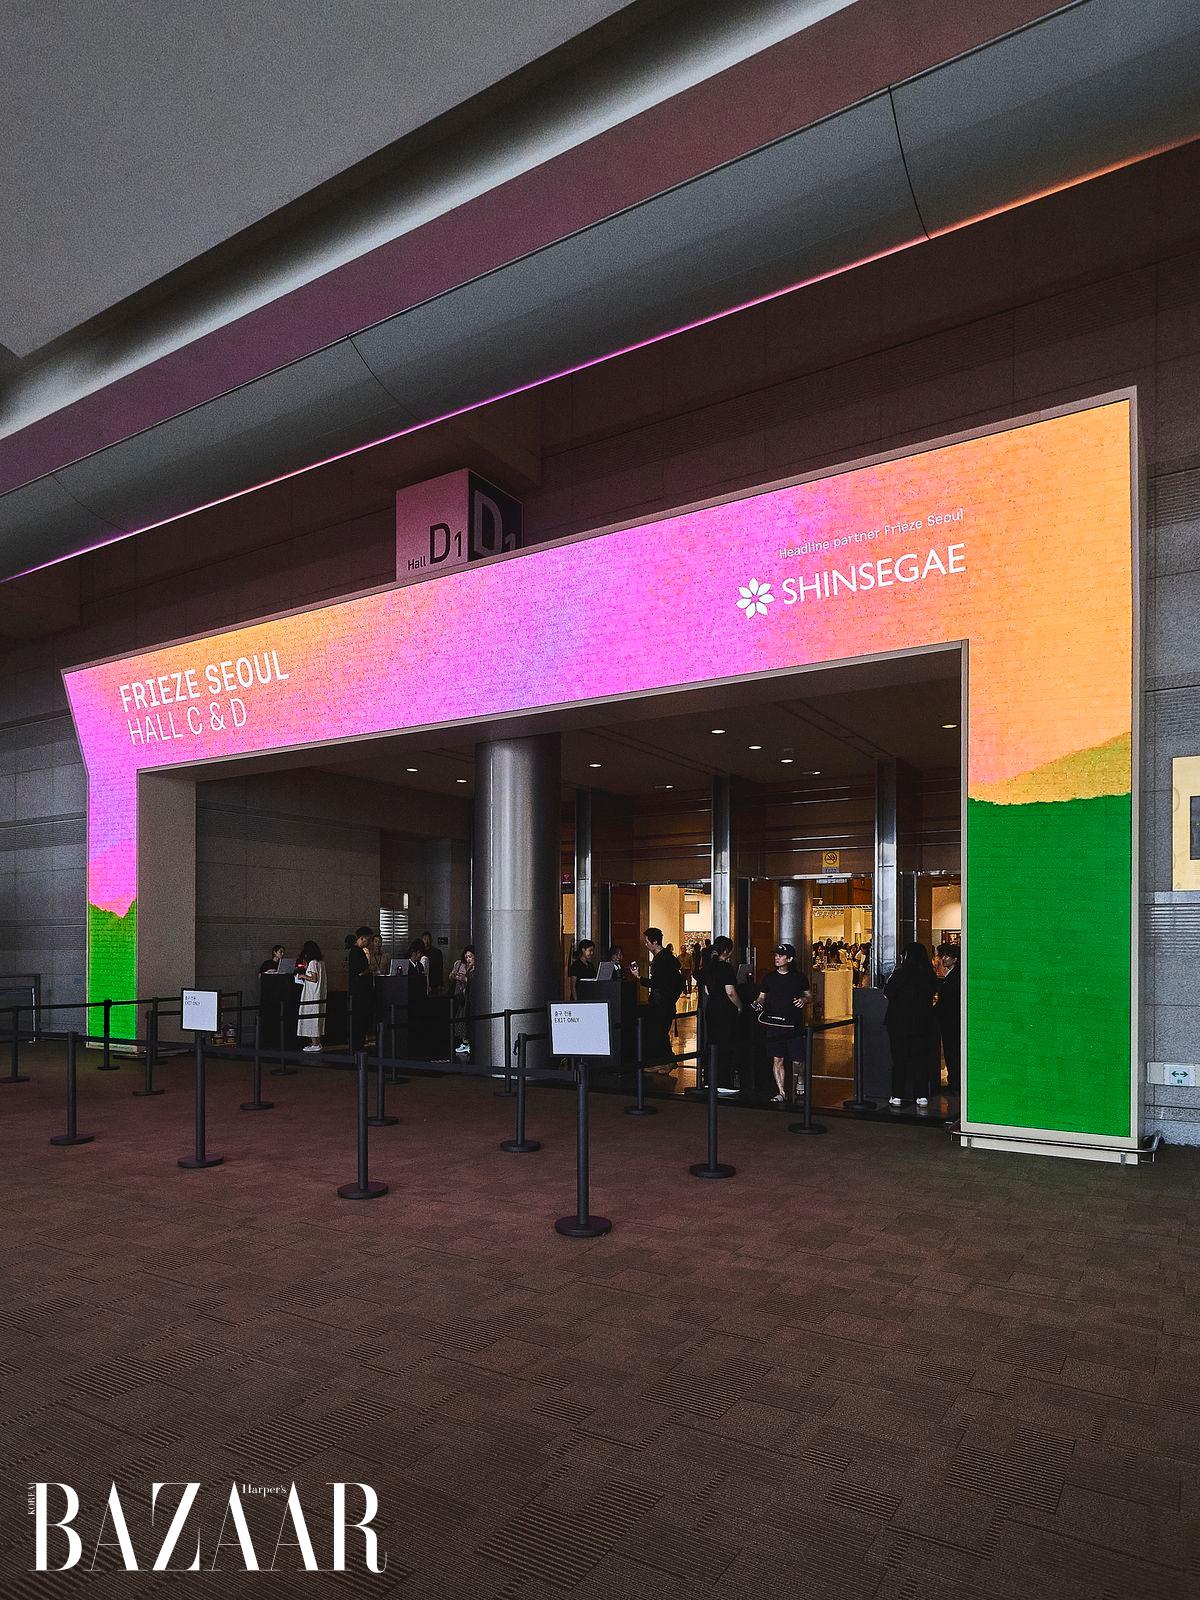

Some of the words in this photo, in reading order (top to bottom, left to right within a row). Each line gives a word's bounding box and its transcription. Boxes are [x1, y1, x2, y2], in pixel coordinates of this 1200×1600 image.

[408, 556, 426, 570] Hall
[430, 523, 462, 564] D1
[779, 540, 830, 559] Headline
[833, 529, 880, 550] partner
[884, 518, 923, 536] Frieze
[927, 508, 964, 527] Seoul
[781, 543, 966, 605] SHINSEGAE
[119, 669, 201, 712] FRIEZE
[204, 650, 290, 695] SEOUL
[127, 711, 184, 745] HALL
[187, 706, 203, 735] C
[209, 702, 227, 731] &
[230, 698, 247, 728] D
